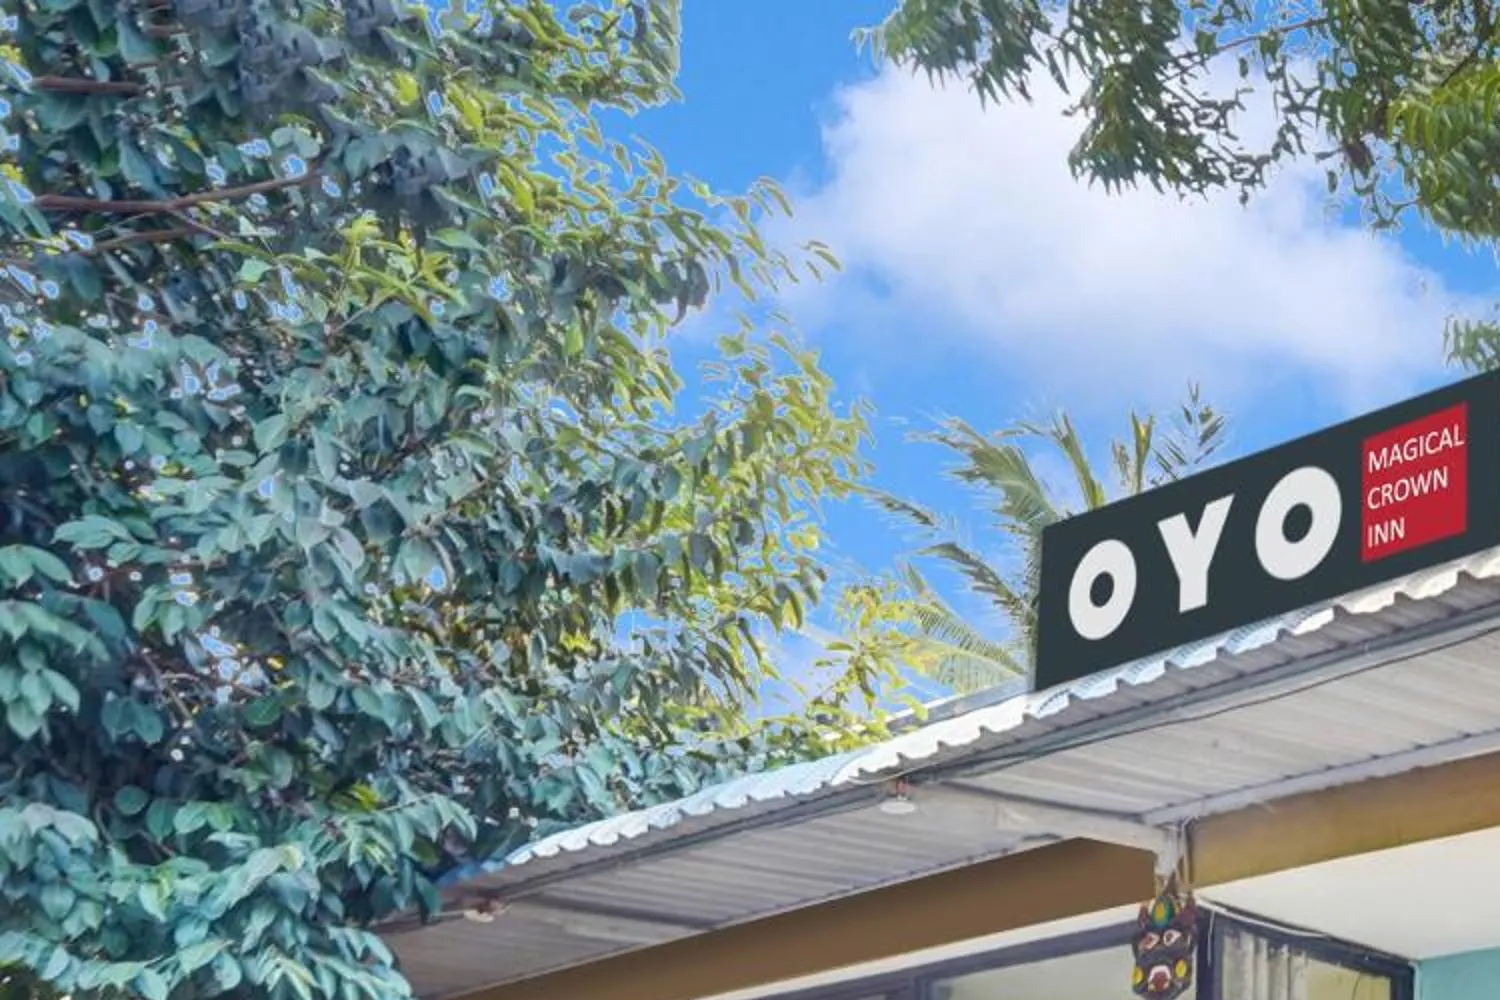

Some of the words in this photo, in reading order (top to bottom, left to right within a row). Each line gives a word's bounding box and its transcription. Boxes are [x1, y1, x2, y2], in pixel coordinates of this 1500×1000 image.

[1368, 424, 1465, 474] MAGICAL
[1367, 465, 1449, 510] CROWN
[1068, 466, 1342, 640] OYO
[1367, 516, 1405, 548] INN
